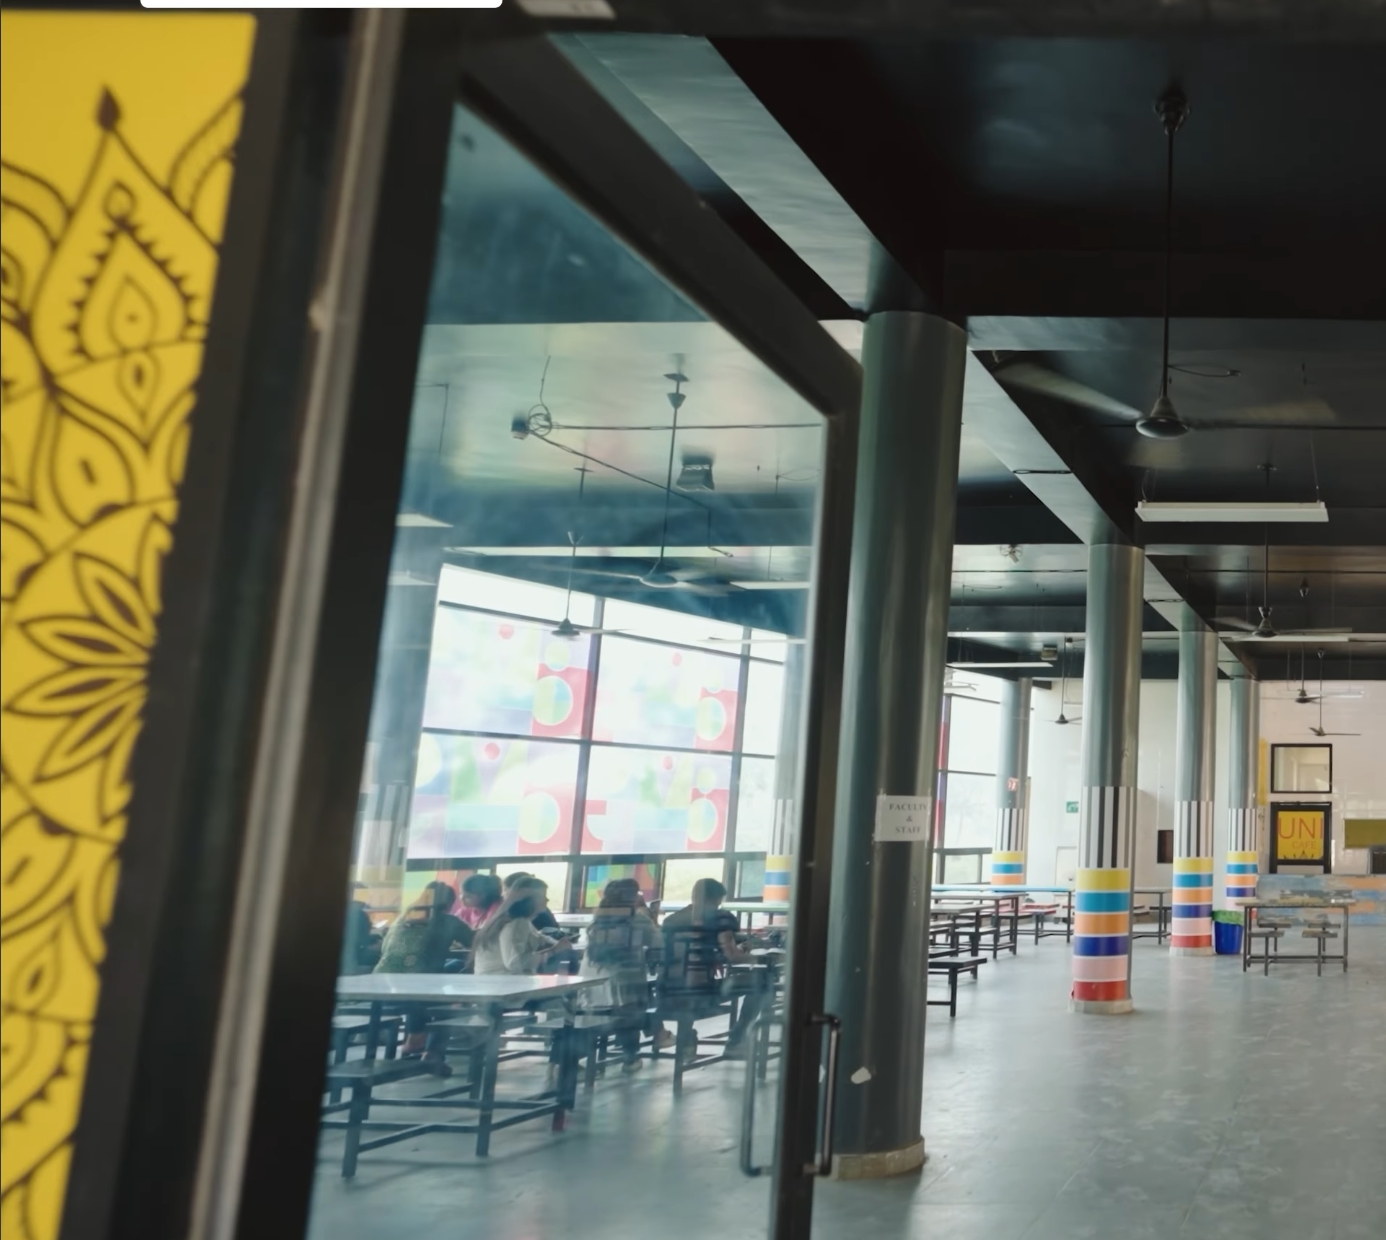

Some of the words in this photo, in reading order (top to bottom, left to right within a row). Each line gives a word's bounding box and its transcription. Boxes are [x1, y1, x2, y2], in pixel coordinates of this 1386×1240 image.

[889, 803, 927, 811] FACULTY
[895, 826, 920, 834] STAFF
[1278, 817, 1323, 839] UNI
